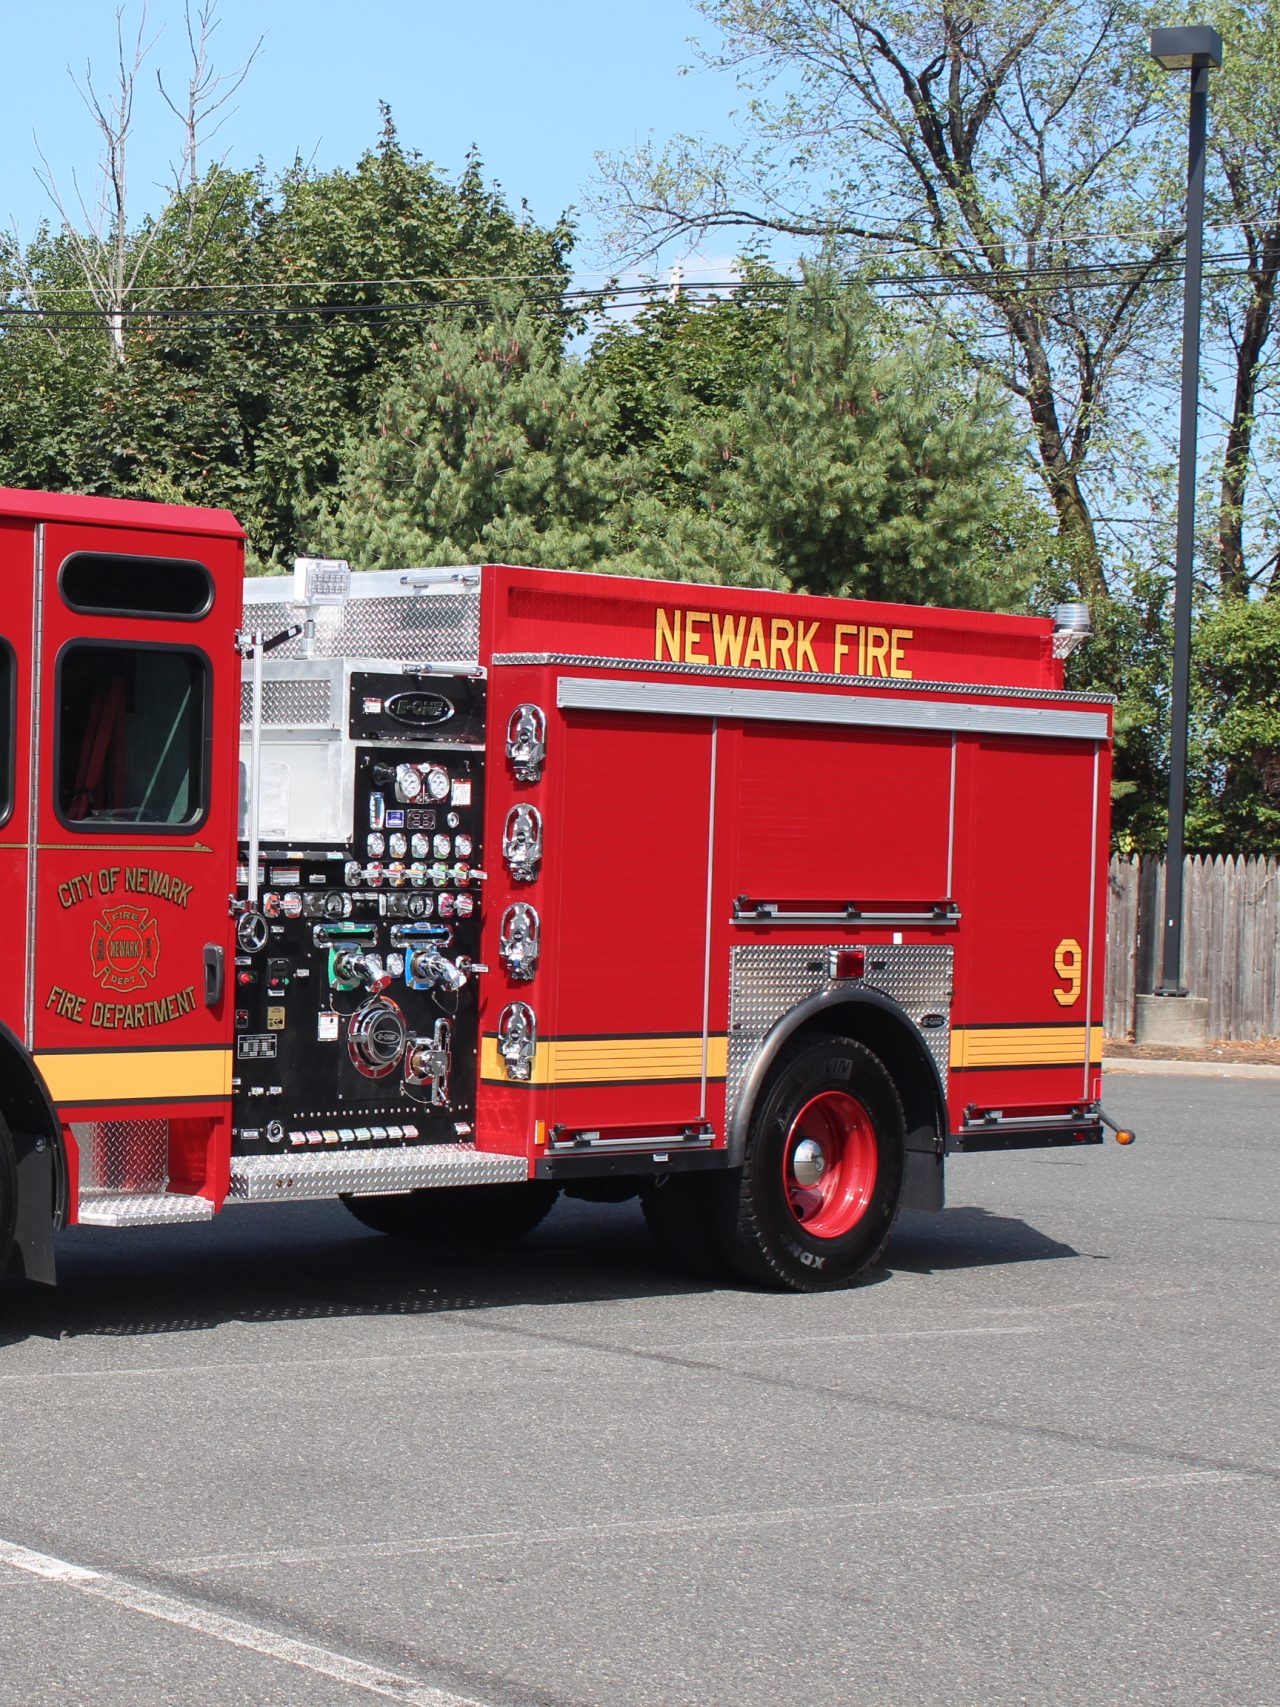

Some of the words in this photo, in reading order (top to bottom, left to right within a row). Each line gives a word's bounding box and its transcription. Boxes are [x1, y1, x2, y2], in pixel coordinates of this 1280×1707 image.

[654, 608, 820, 673] NEWARK
[834, 624, 913, 679] FIRE
[396, 700, 444, 716] E-ONE
[58, 872, 93, 909] CITY
[98, 867, 120, 893] OF
[125, 867, 193, 909] NEWARK
[112, 911, 138, 921] FIRE
[111, 941, 139, 958] NEWARK
[112, 975, 136, 985] DEPT
[1053, 938, 1082, 1006] 9
[46, 985, 86, 1022] FIRE
[91, 986, 196, 1029] DEPARTMENT
